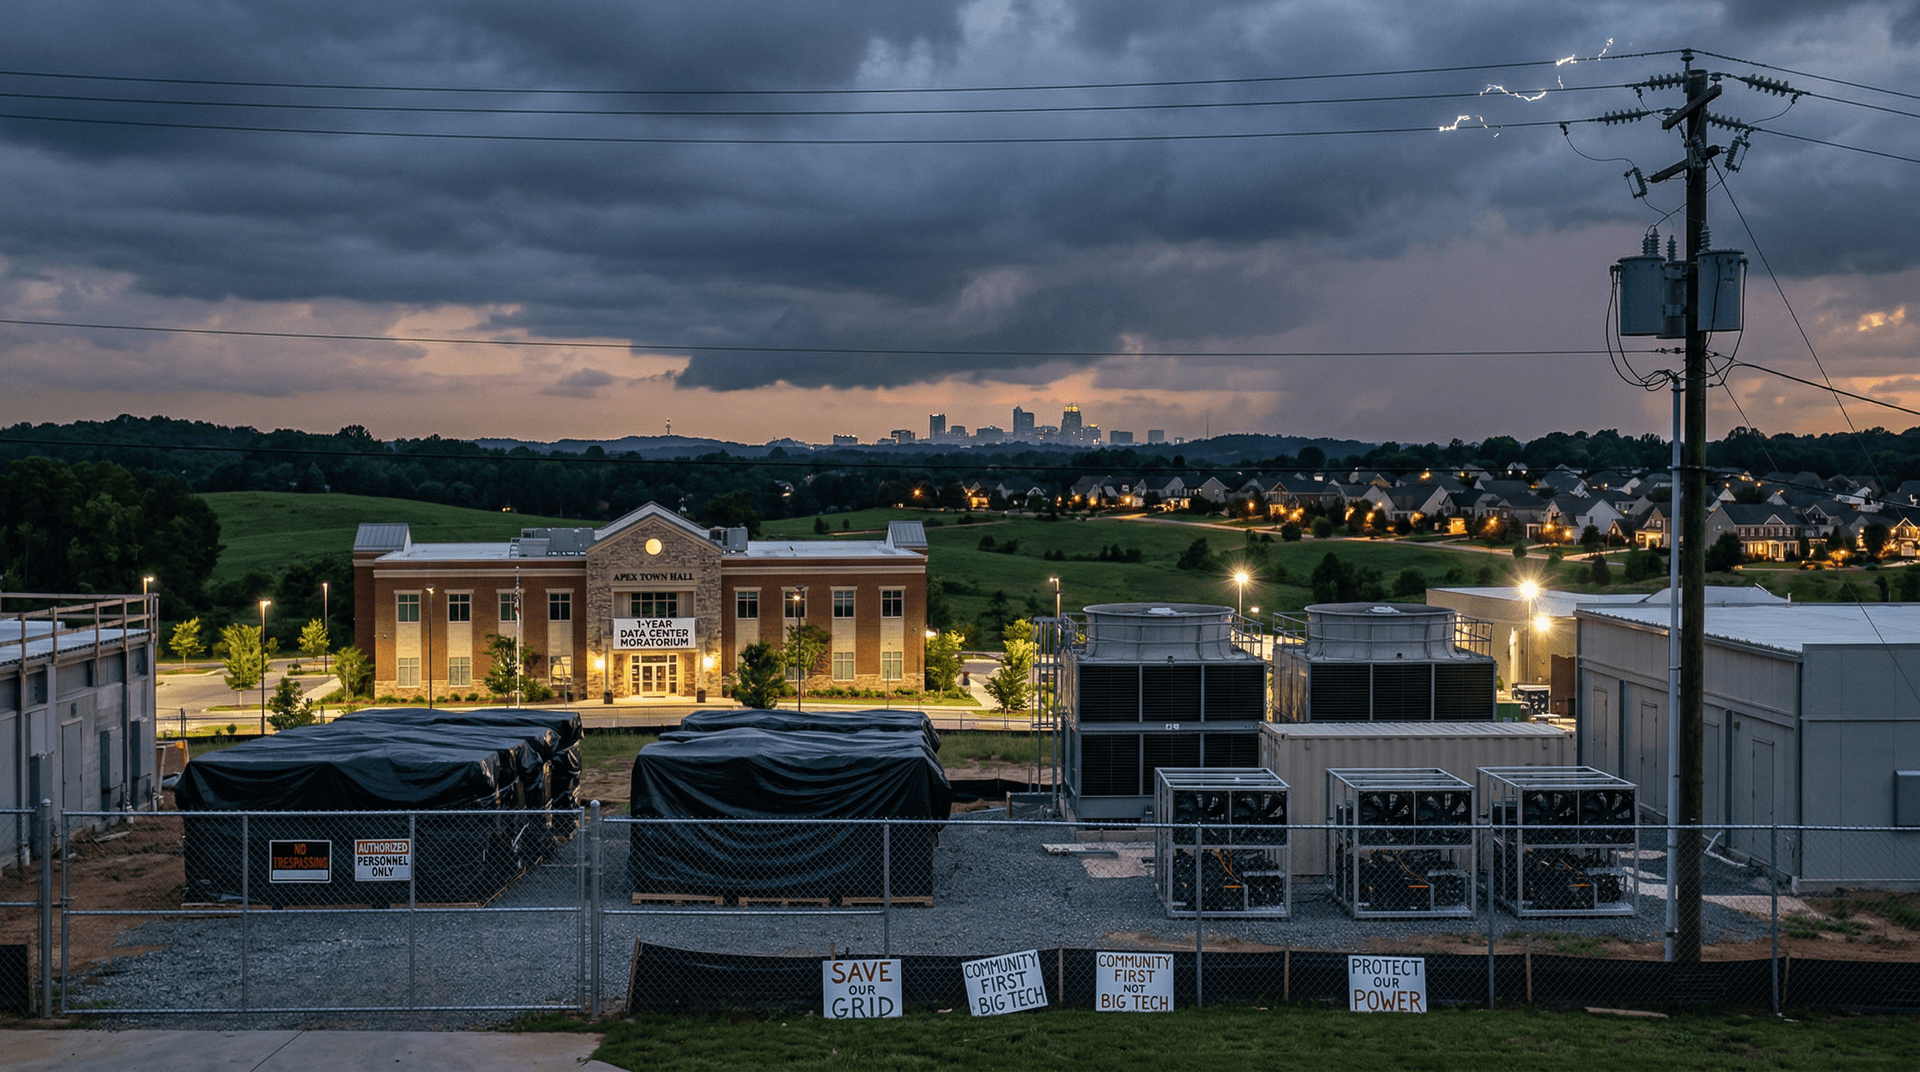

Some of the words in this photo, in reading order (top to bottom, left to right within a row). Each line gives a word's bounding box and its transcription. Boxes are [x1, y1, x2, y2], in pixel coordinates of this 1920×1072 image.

[613, 573, 638, 582] APEX
[640, 573, 668, 581] TOWN
[670, 572, 695, 581] HALL
[636, 620, 673, 628] 1-YEAR
[620, 629, 646, 638] DATA
[649, 629, 689, 637] CENTER
[620, 638, 689, 647] MORATORIUM
[294, 843, 307, 856] NO
[358, 842, 408, 854] AUTHORIZED
[273, 856, 328, 869] TRESPASSING
[357, 856, 409, 866] PERSONNEL
[371, 866, 394, 877] ONLY
[965, 951, 1037, 979] COMMUNITY
[1098, 954, 1171, 970] COMMUNITY
[1352, 958, 1422, 976] PROTECT
[831, 961, 893, 984] SAVE
[1114, 969, 1155, 983] FIRST
[980, 971, 1027, 995] FIRST
[1123, 984, 1145, 993] NOT
[1373, 976, 1400, 988] OUR
[848, 984, 876, 995] OUR
[831, 996, 894, 1018] GRID
[978, 994, 1006, 1015] BIG
[1010, 986, 1046, 1009] TECH
[1101, 993, 1126, 1009] BIG
[1132, 995, 1169, 1011] TECH
[1354, 989, 1422, 1012] POWER
